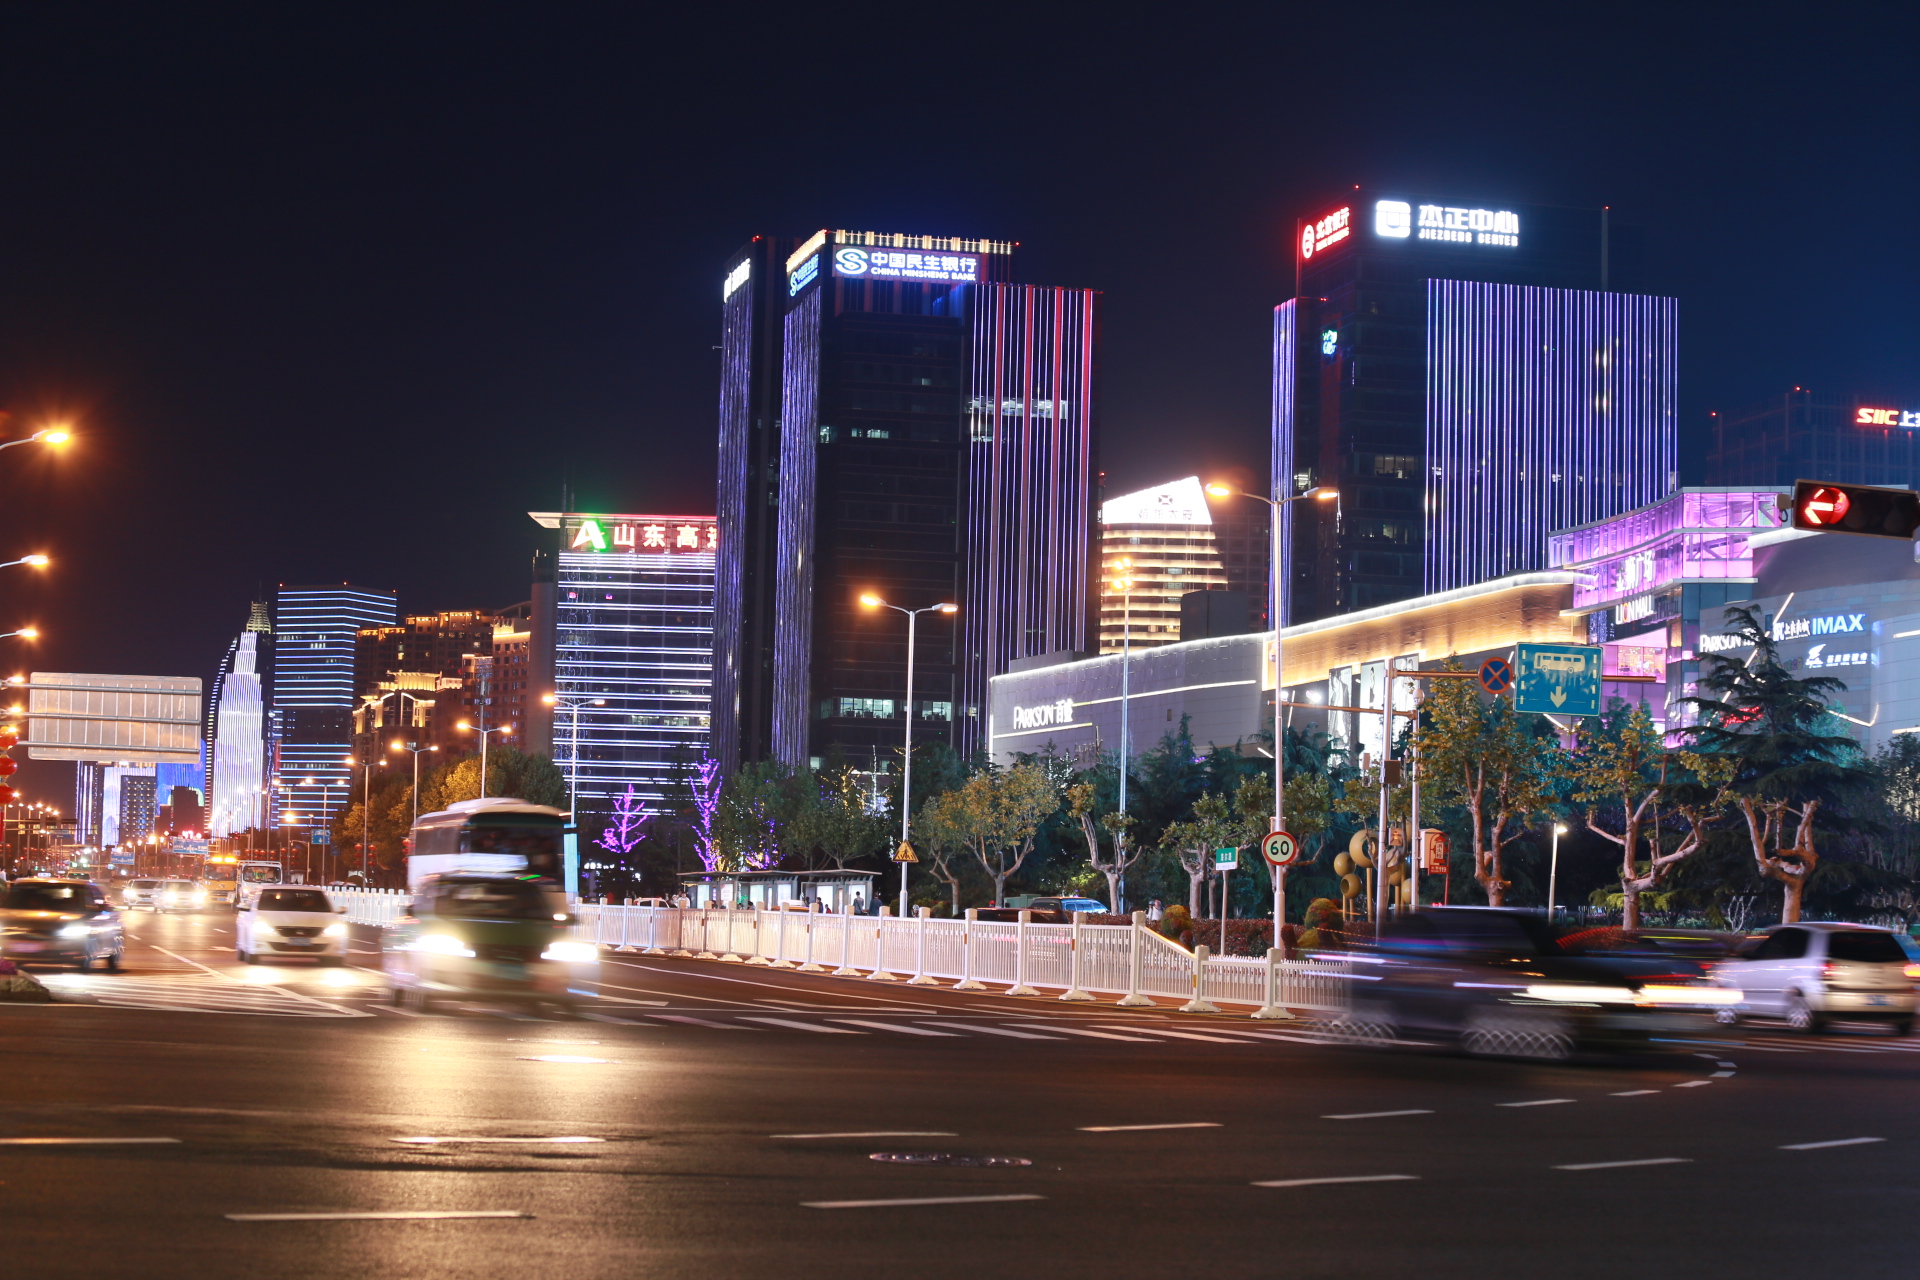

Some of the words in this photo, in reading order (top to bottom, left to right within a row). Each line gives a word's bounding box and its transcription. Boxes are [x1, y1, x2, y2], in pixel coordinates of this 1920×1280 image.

[1418, 204, 1519, 234] 杰正中心
[1477, 232, 1518, 247] CENTER
[871, 251, 977, 273] 中国民生银行
[870, 266, 901, 277] CHINA
[901, 269, 950, 280] MINSHENG
[951, 272, 977, 281] BANK
[1856, 408, 1899, 425] SIIC
[1812, 614, 1864, 635] IMAX
[1013, 705, 1054, 730] PARKSON
[1270, 840, 1290, 856] 60
